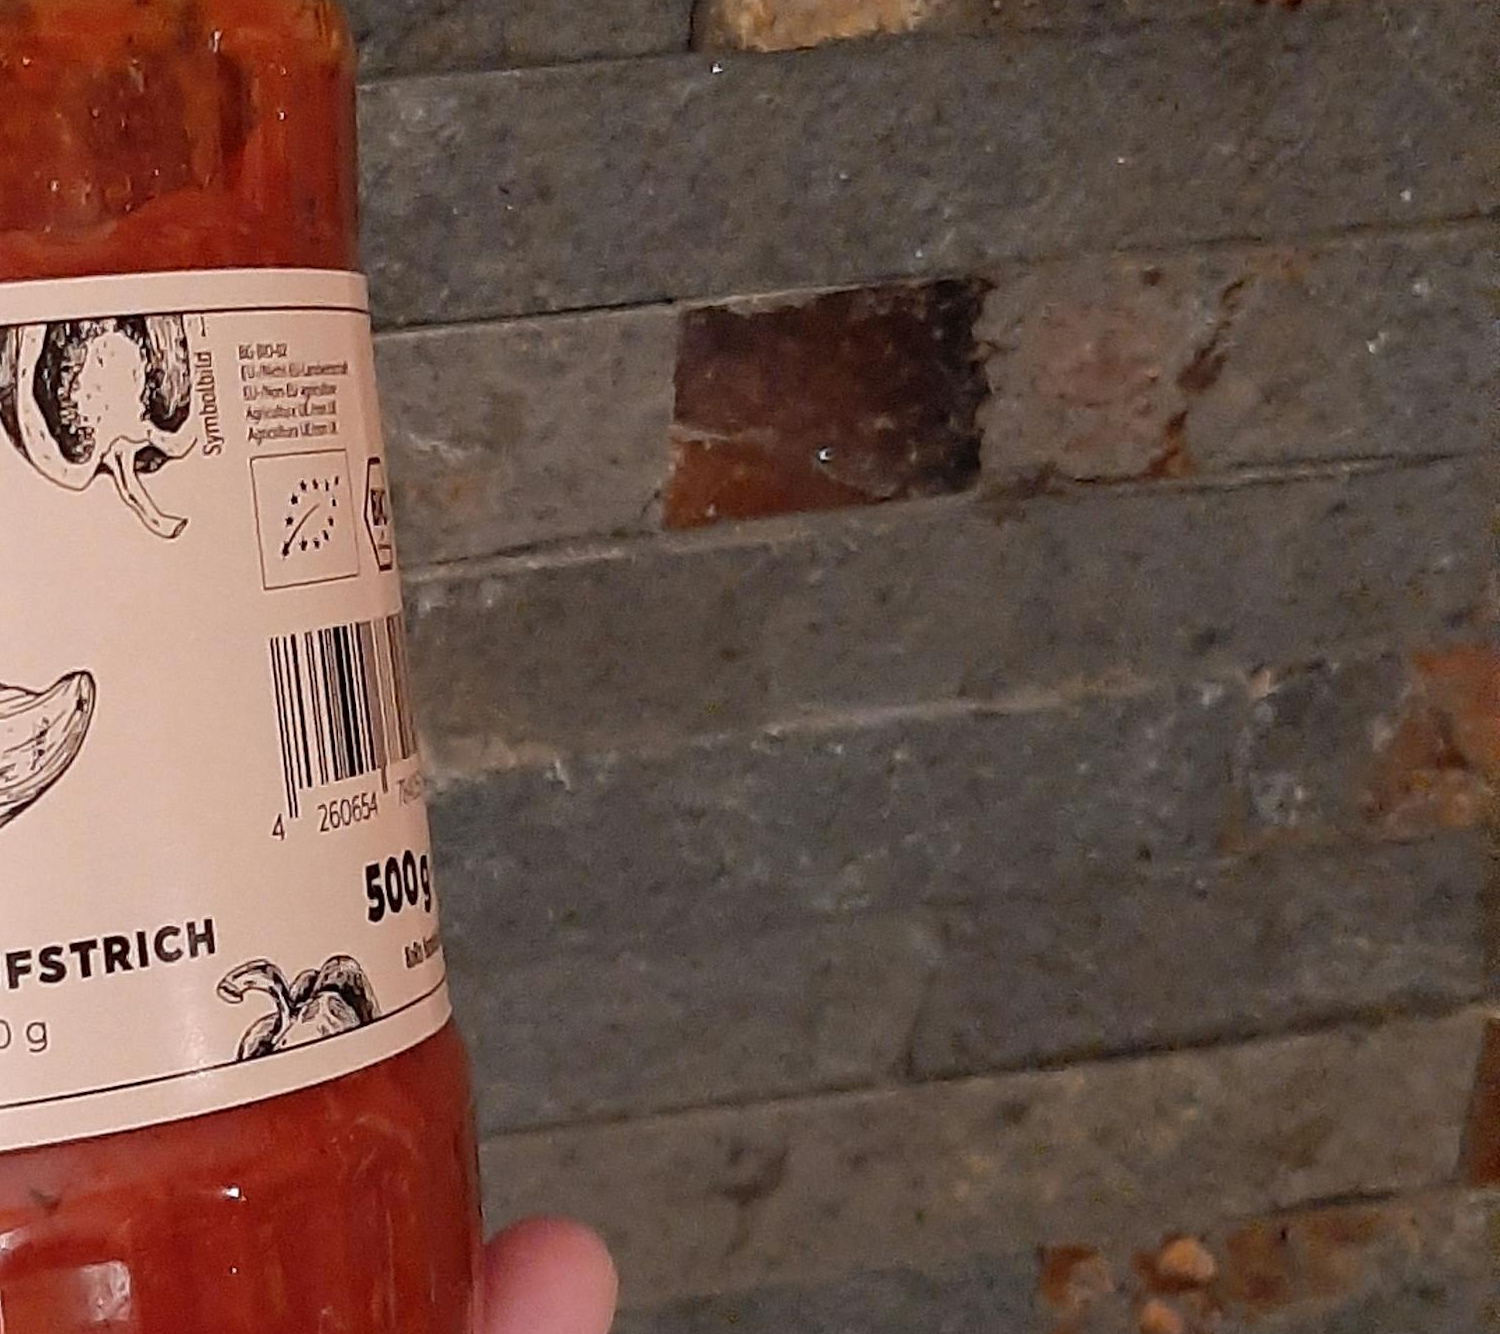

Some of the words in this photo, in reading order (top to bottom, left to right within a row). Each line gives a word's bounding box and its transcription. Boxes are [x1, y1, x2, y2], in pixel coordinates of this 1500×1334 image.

[194, 350, 225, 456] Symbolbild
[272, 813, 286, 841] 4
[317, 791, 378, 833] 260654
[365, 849, 431, 923] 500g
[25, 1021, 49, 1053] g
